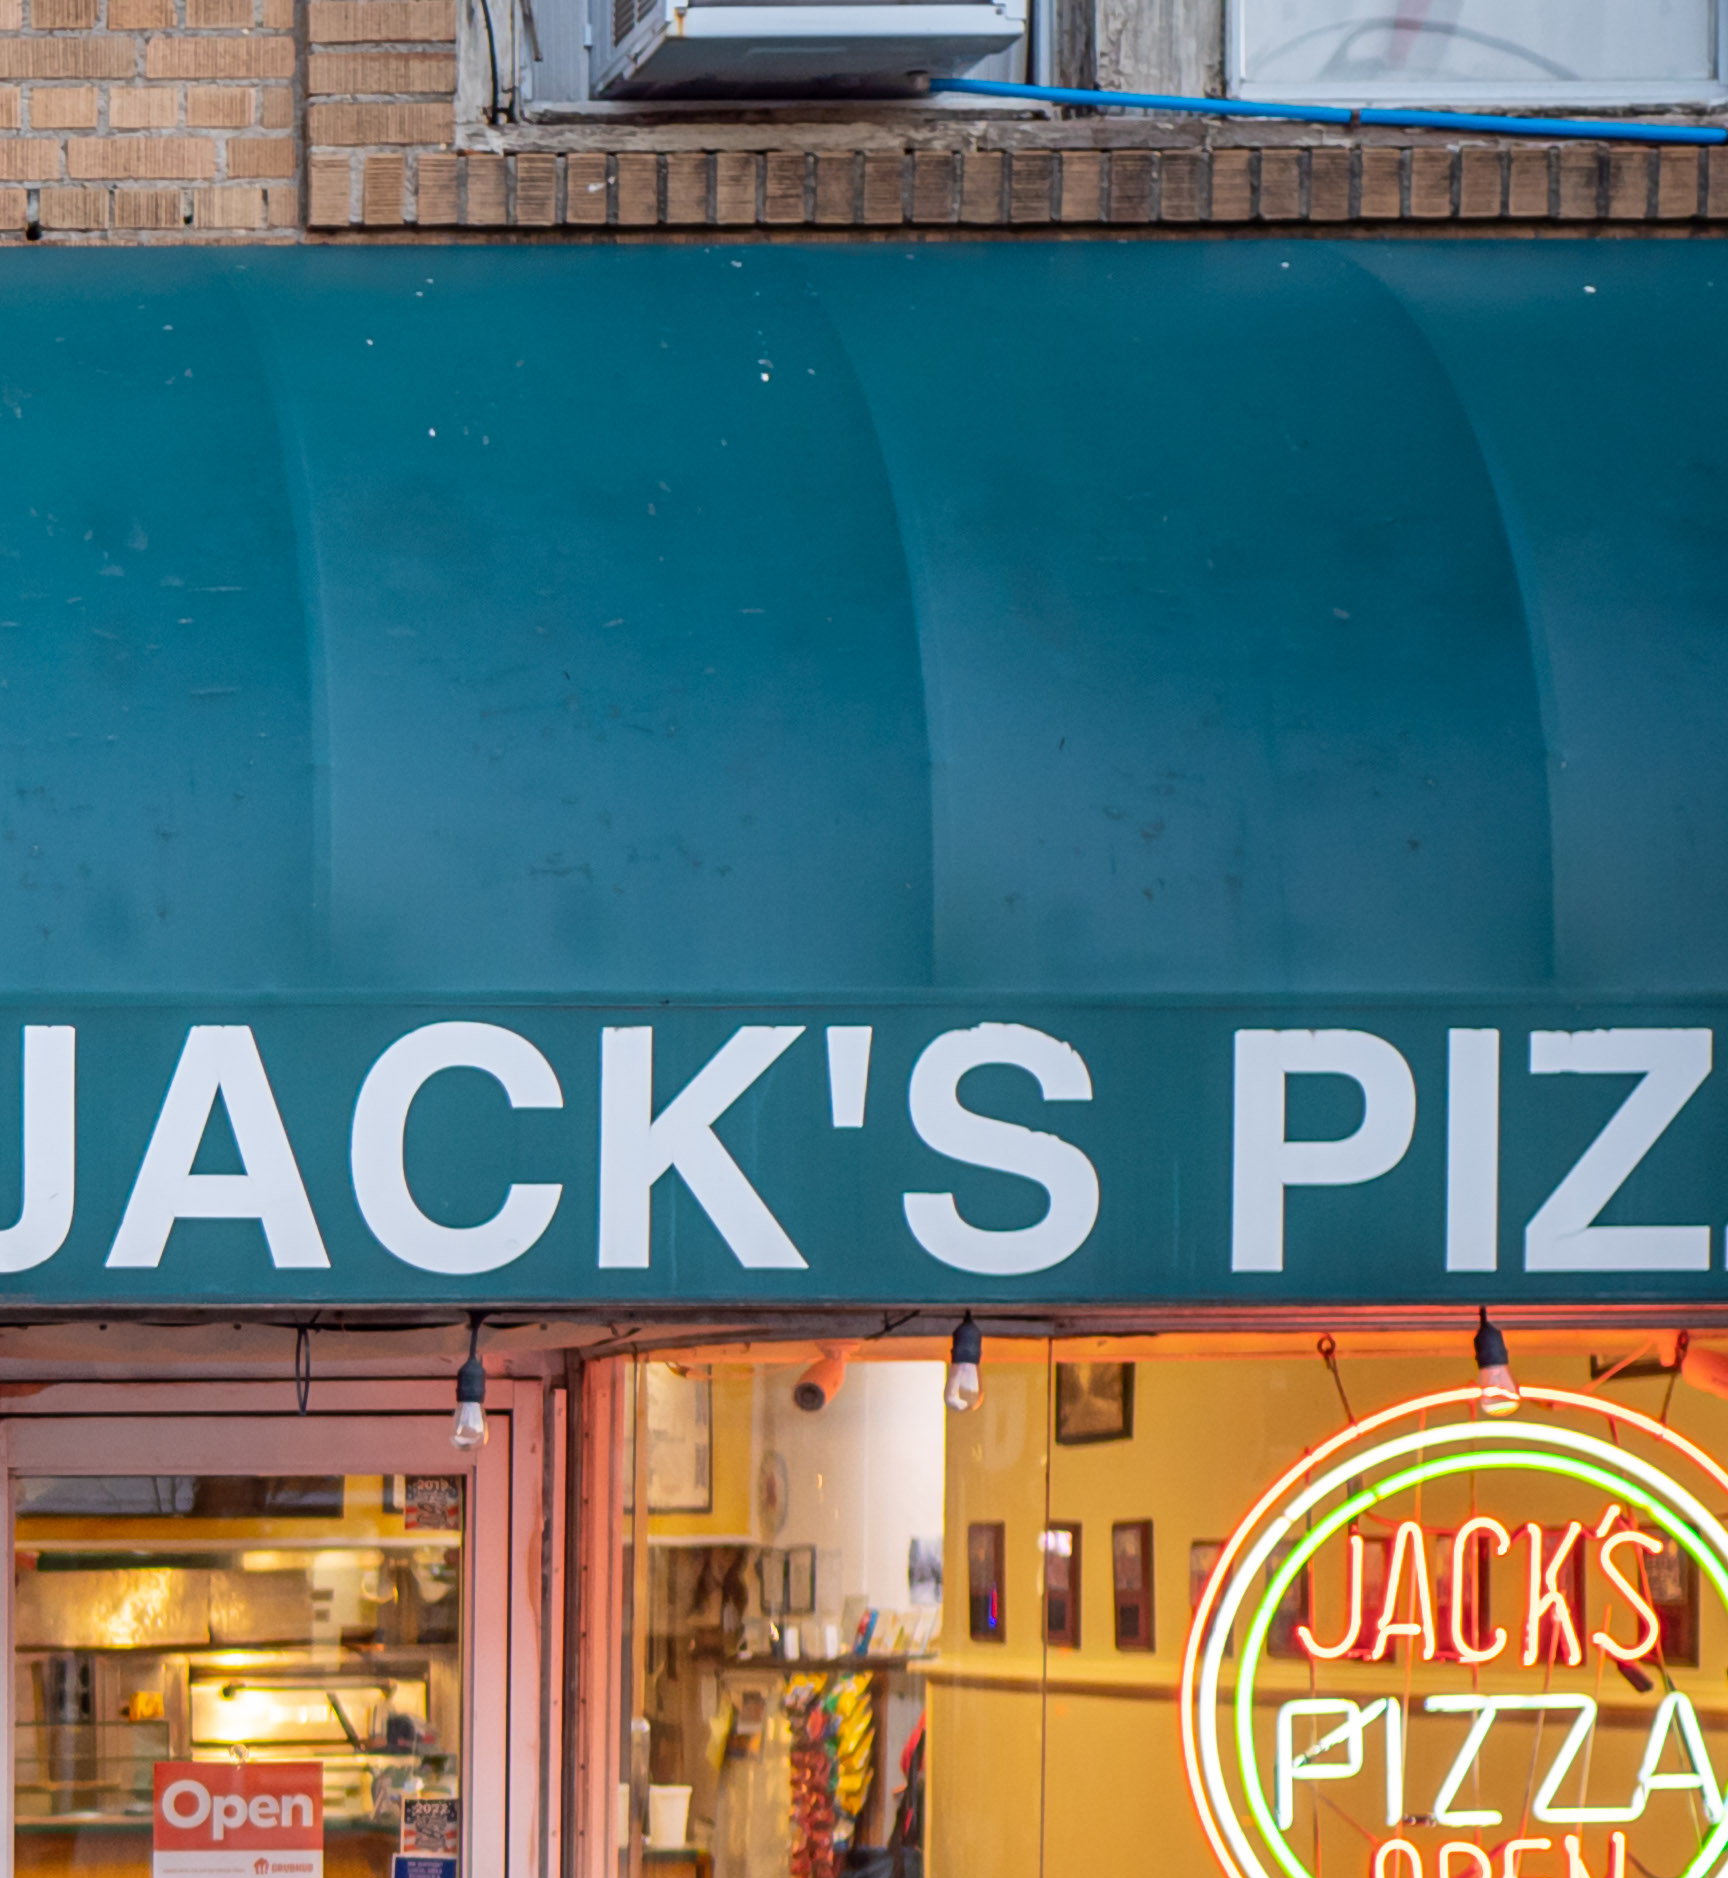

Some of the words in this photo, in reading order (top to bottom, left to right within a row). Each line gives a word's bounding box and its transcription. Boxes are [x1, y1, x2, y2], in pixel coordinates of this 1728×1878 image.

[1230, 1026, 1728, 1273] PIZ
[1295, 1505, 1664, 1666] JACK'S
[161, 1779, 314, 1841] Open
[1274, 1692, 1727, 1831] PIZZA
